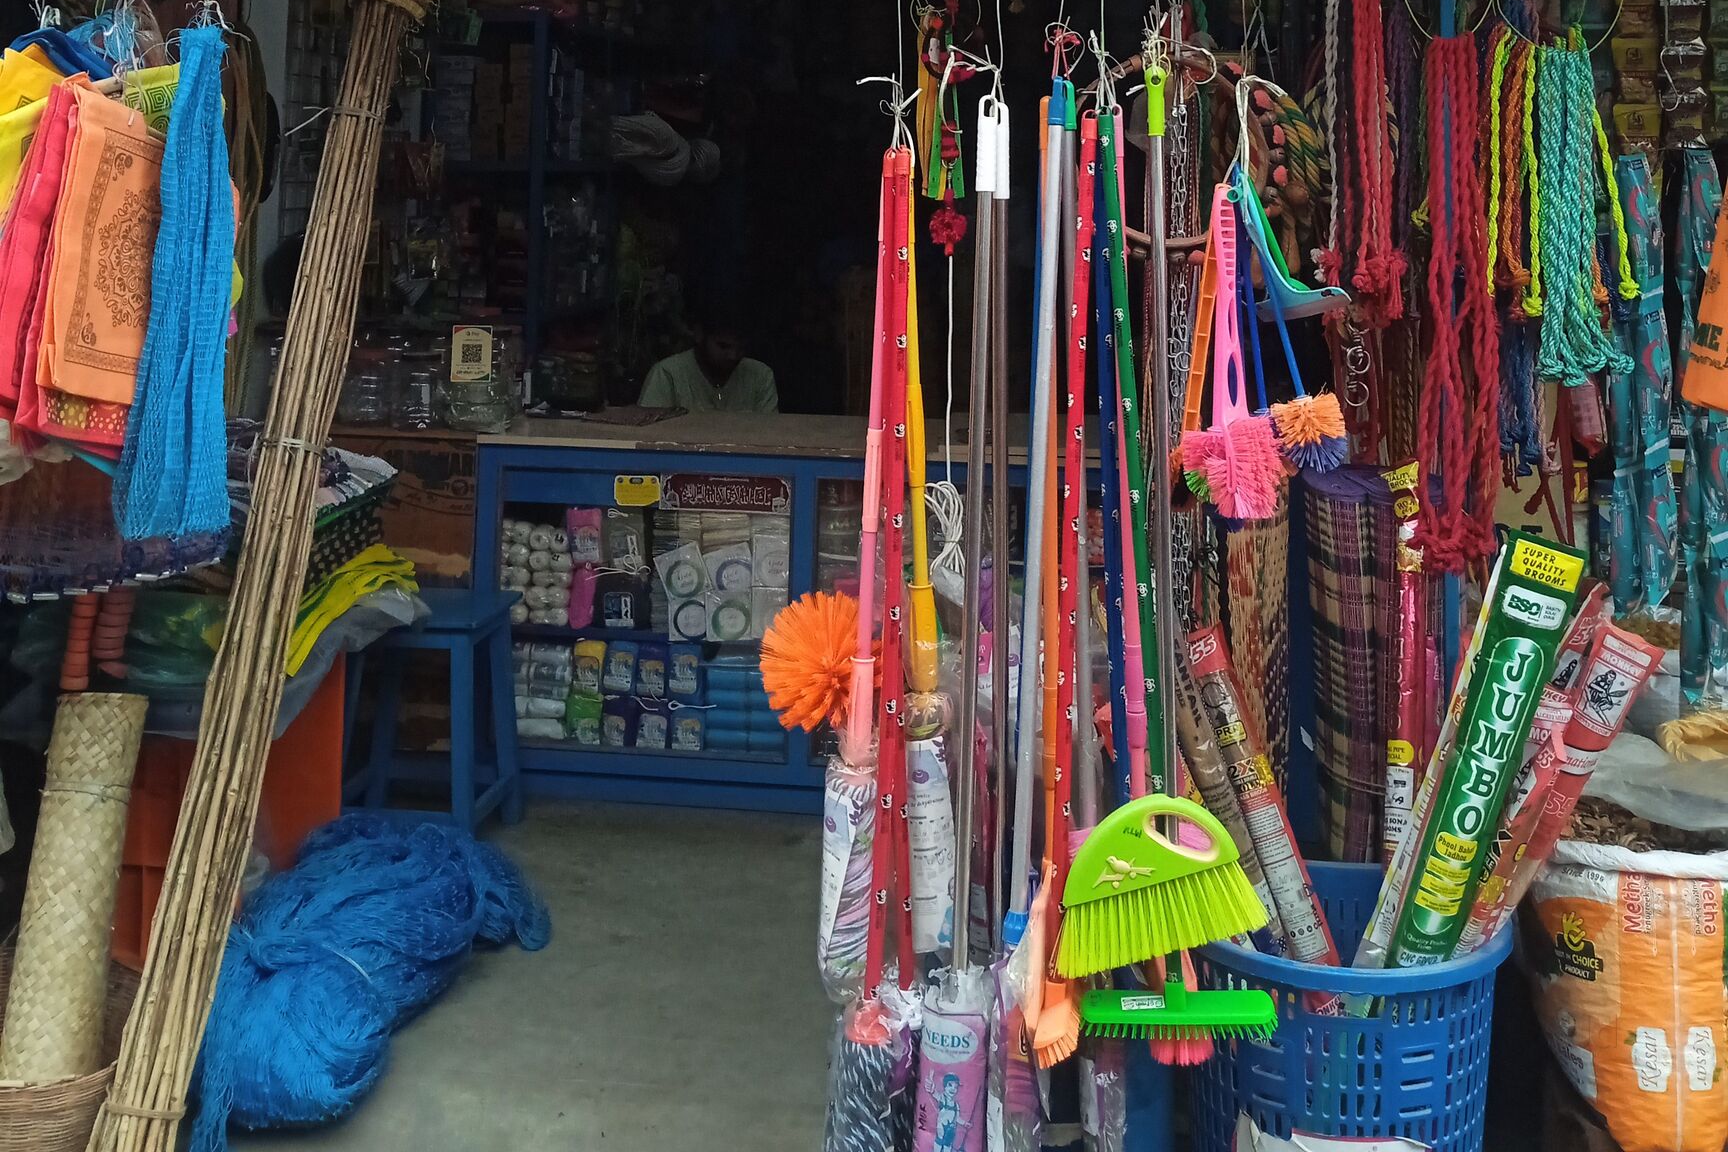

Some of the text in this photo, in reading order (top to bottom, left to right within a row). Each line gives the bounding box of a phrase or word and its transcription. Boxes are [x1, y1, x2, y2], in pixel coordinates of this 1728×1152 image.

[1522, 547, 1557, 564] SUPER
[1522, 557, 1566, 577] QUALITY
[1524, 567, 1567, 587] BROOMS
[1452, 651, 1536, 837] JUMBO
[1571, 953, 1600, 970] CHOICE
[924, 1024, 971, 1049] NEEDS
